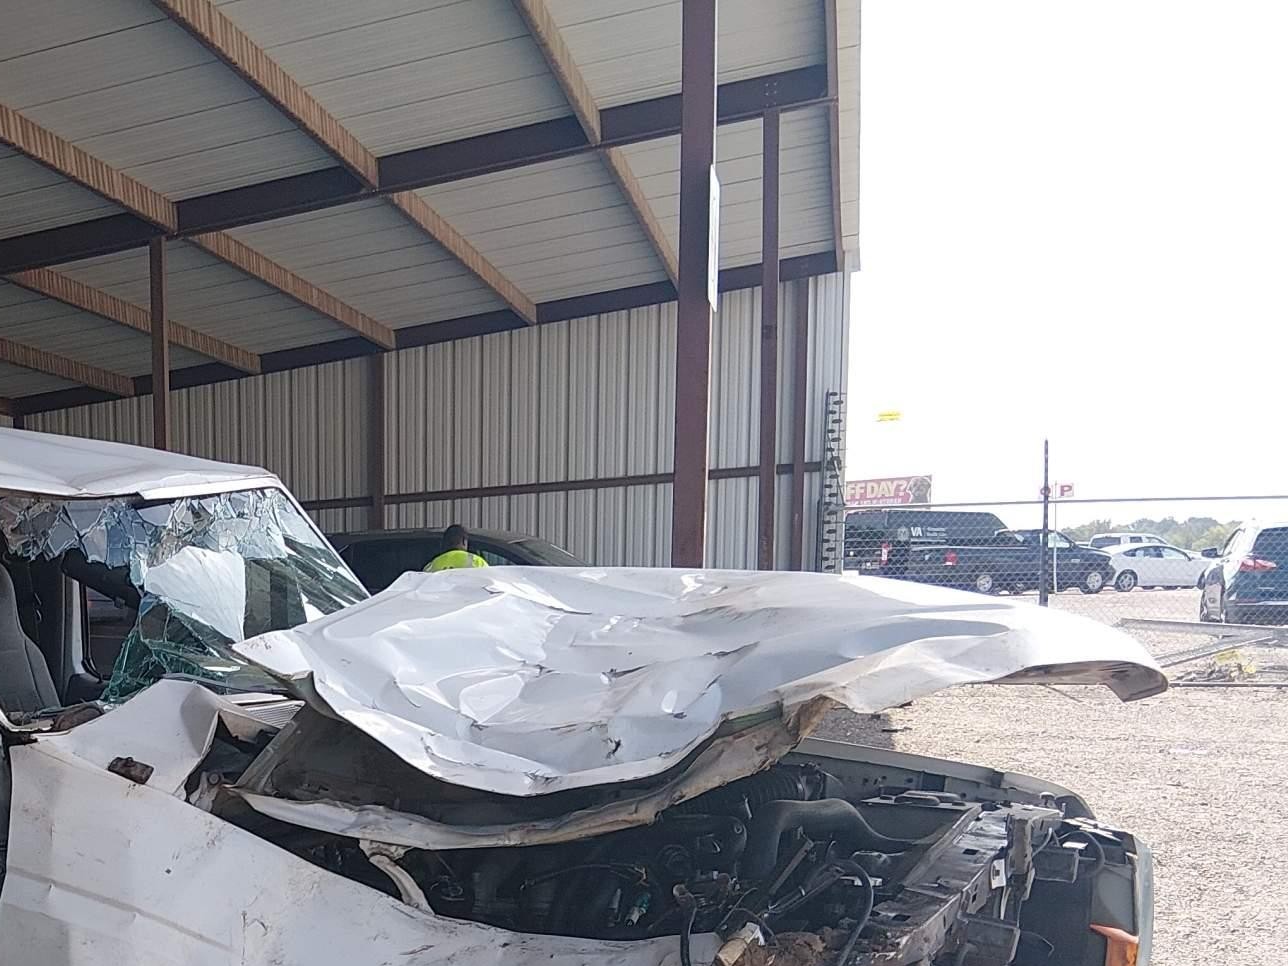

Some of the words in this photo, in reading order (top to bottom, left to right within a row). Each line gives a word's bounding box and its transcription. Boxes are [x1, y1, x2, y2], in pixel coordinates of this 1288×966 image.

[866, 479, 908, 499] DAY?
[1060, 484, 1073, 497] P
[910, 526, 923, 537] VA
